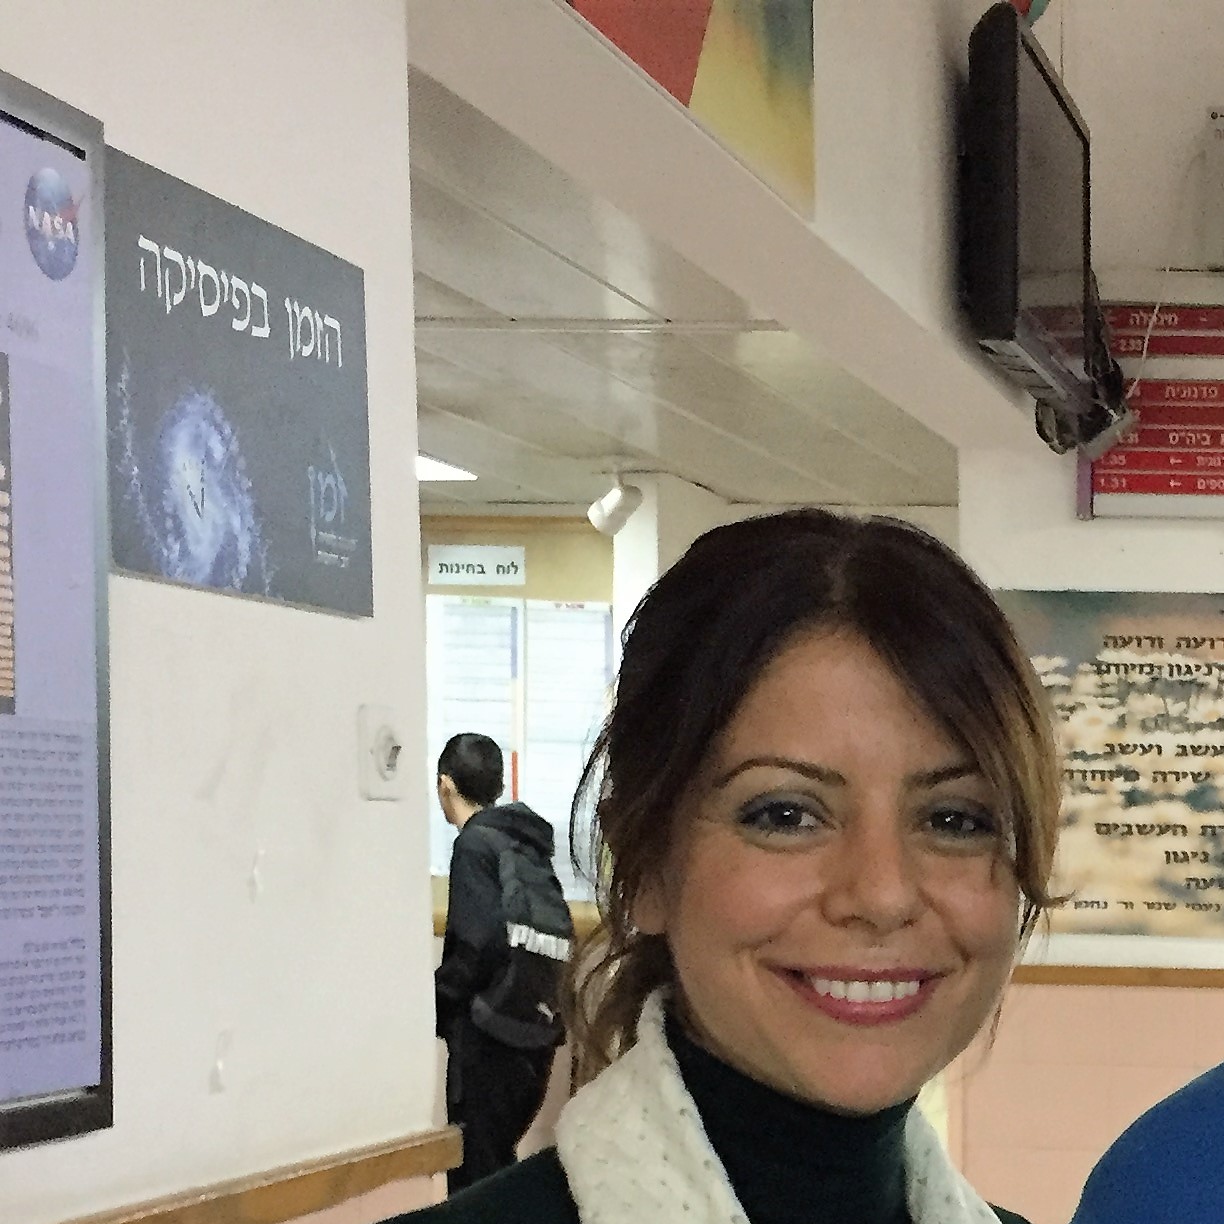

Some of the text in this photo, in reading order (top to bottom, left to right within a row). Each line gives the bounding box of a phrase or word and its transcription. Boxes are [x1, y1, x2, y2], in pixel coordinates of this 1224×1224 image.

[137, 234, 343, 369] הזמן בפיסיקה
[437, 561, 519, 575] לוח בחינות
[1151, 769, 1212, 784] שירה
[1094, 822, 1189, 838] העשבים
[1163, 849, 1210, 865] ניגון
